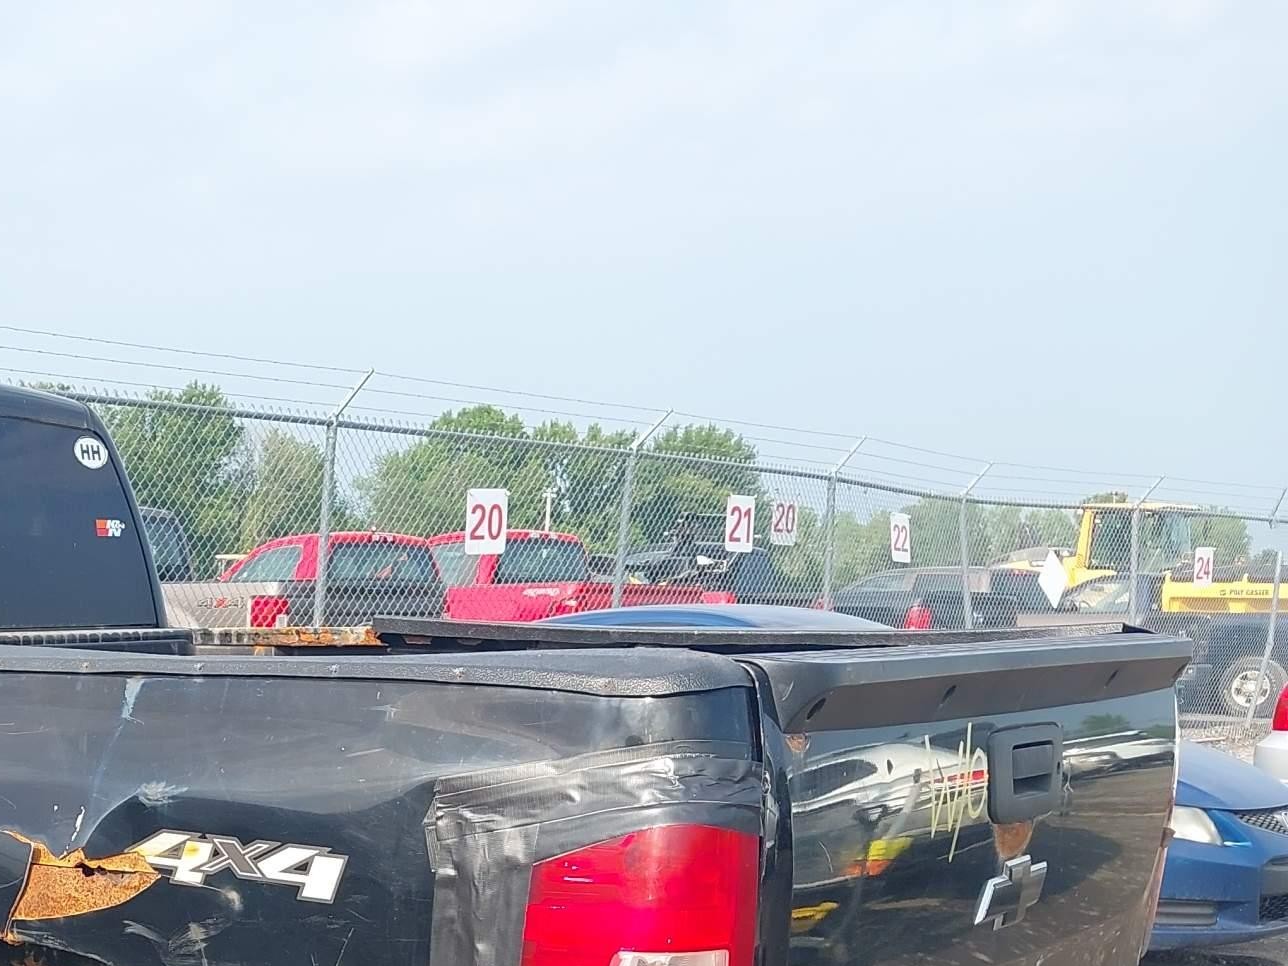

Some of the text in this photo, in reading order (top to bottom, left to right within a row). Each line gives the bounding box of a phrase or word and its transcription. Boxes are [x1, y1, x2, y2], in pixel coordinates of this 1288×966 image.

[80, 443, 101, 461] HH
[469, 503, 503, 540] 20
[728, 505, 753, 544] 21
[773, 503, 796, 534] 20
[893, 524, 909, 552] 22
[1195, 556, 1211, 580] 24
